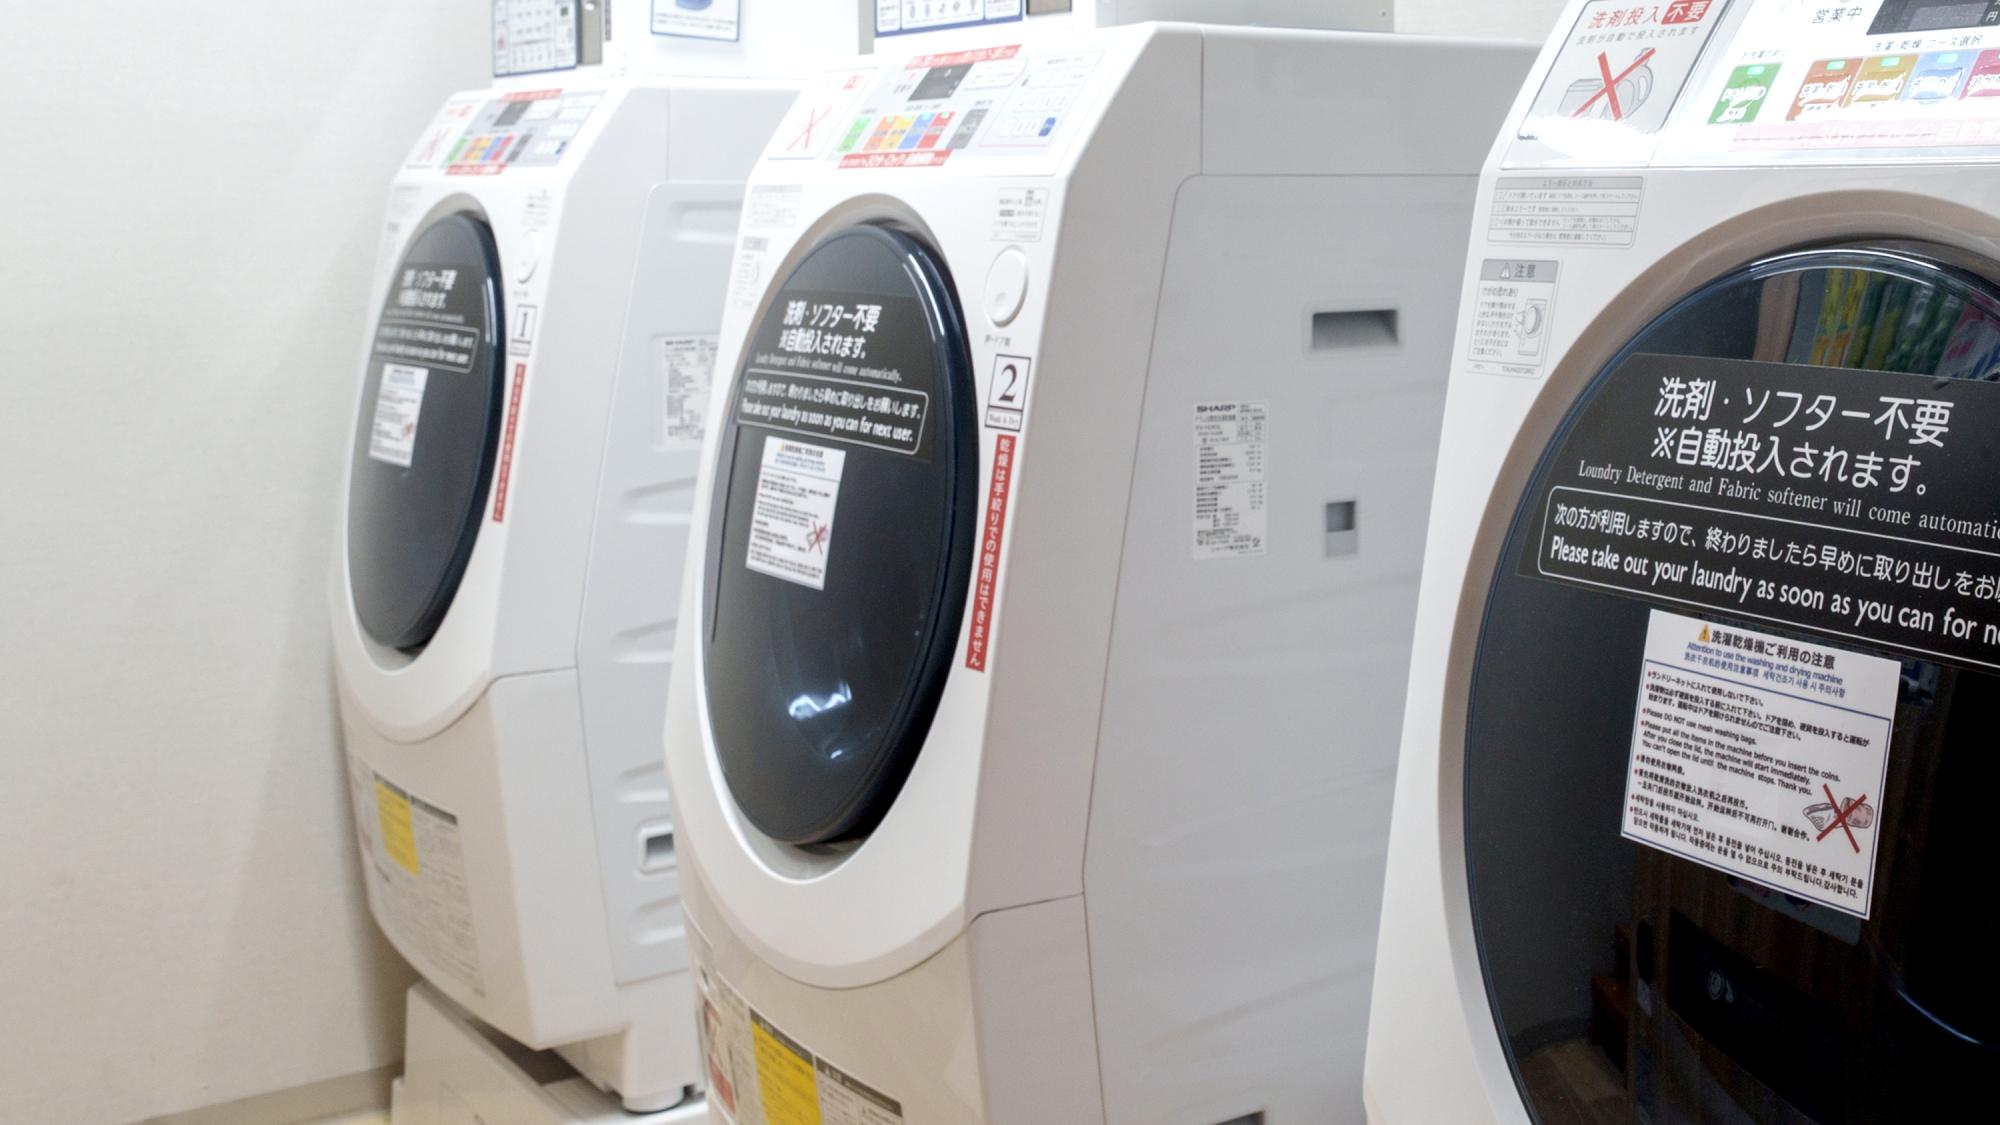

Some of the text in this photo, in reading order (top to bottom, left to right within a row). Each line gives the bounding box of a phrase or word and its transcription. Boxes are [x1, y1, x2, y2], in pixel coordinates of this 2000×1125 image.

[1587, 1, 1708, 29] 洗剤投入 不要
[1812, 6, 1864, 24] 営業中
[1515, 264, 1536, 279] 注意
[521, 310, 530, 338] 1
[783, 300, 882, 333] 洗剤・ソフター不要
[778, 329, 867, 359] ※自動投入されます。
[998, 363, 1017, 402] 2
[1196, 404, 1236, 413] SHARP
[1654, 376, 1954, 448] 洗剤・ソフター不要
[832, 416, 845, 433] you
[846, 418, 859, 431] can
[860, 416, 873, 433] for
[873, 423, 892, 437] next
[893, 426, 914, 441] user.
[1651, 426, 1927, 496] ※自動投入されます。
[1578, 460, 1622, 484] Loundry
[1626, 466, 1683, 490] Detergent
[1689, 477, 1712, 493] and
[1718, 478, 1761, 500] Fabric
[1768, 487, 1828, 510] softener
[1834, 498, 1861, 517] will
[1869, 507, 1910, 524] come
[1550, 535, 2000, 644] Please take out your laundry as soon as you can for n
[1687, 643, 1844, 685] Attention to use the washing and drying machine
[1712, 630, 1835, 670] 洗濯乾燥機ご利用の注意
[1647, 709, 1663, 719] Please
[1664, 714, 1673, 722] DO
[1674, 716, 1685, 725] NOT
[1687, 719, 1697, 728] use
[1715, 727, 1740, 740] washing
[1642, 740, 1652, 748] You
[1652, 743, 1666, 752] can't
[1667, 747, 1680, 756] open
[1682, 751, 1691, 759] the
[1701, 756, 1714, 766] until
[1718, 761, 1728, 770] the
[1729, 764, 1755, 778] machine
[1758, 773, 1777, 784] stops.
[1778, 779, 1797, 790] Thank
[1799, 785, 1813, 795] you.
[1643, 731, 1656, 741] After
[1658, 735, 1667, 744] you
[1668, 738, 1682, 748] close
[1684, 742, 1693, 751] the
[1704, 748, 1714, 757] the
[1715, 751, 1741, 765] machine
[1743, 758, 1753, 768] will
[1755, 762, 1769, 772] start
[1771, 766, 1811, 784] immediately.
[1645, 721, 1663, 732] Please
[1663, 726, 1672, 734] put
[1681, 731, 1690, 739] the
[1691, 734, 1707, 744] items
[1715, 741, 1726, 749] the
[1727, 744, 1753, 757] machine
[1754, 752, 1774, 763] before
[1775, 758, 1786, 767] you
[1788, 761, 1807, 773] insert
[1808, 767, 1820, 776] the
[1821, 770, 1841, 782] coins.
